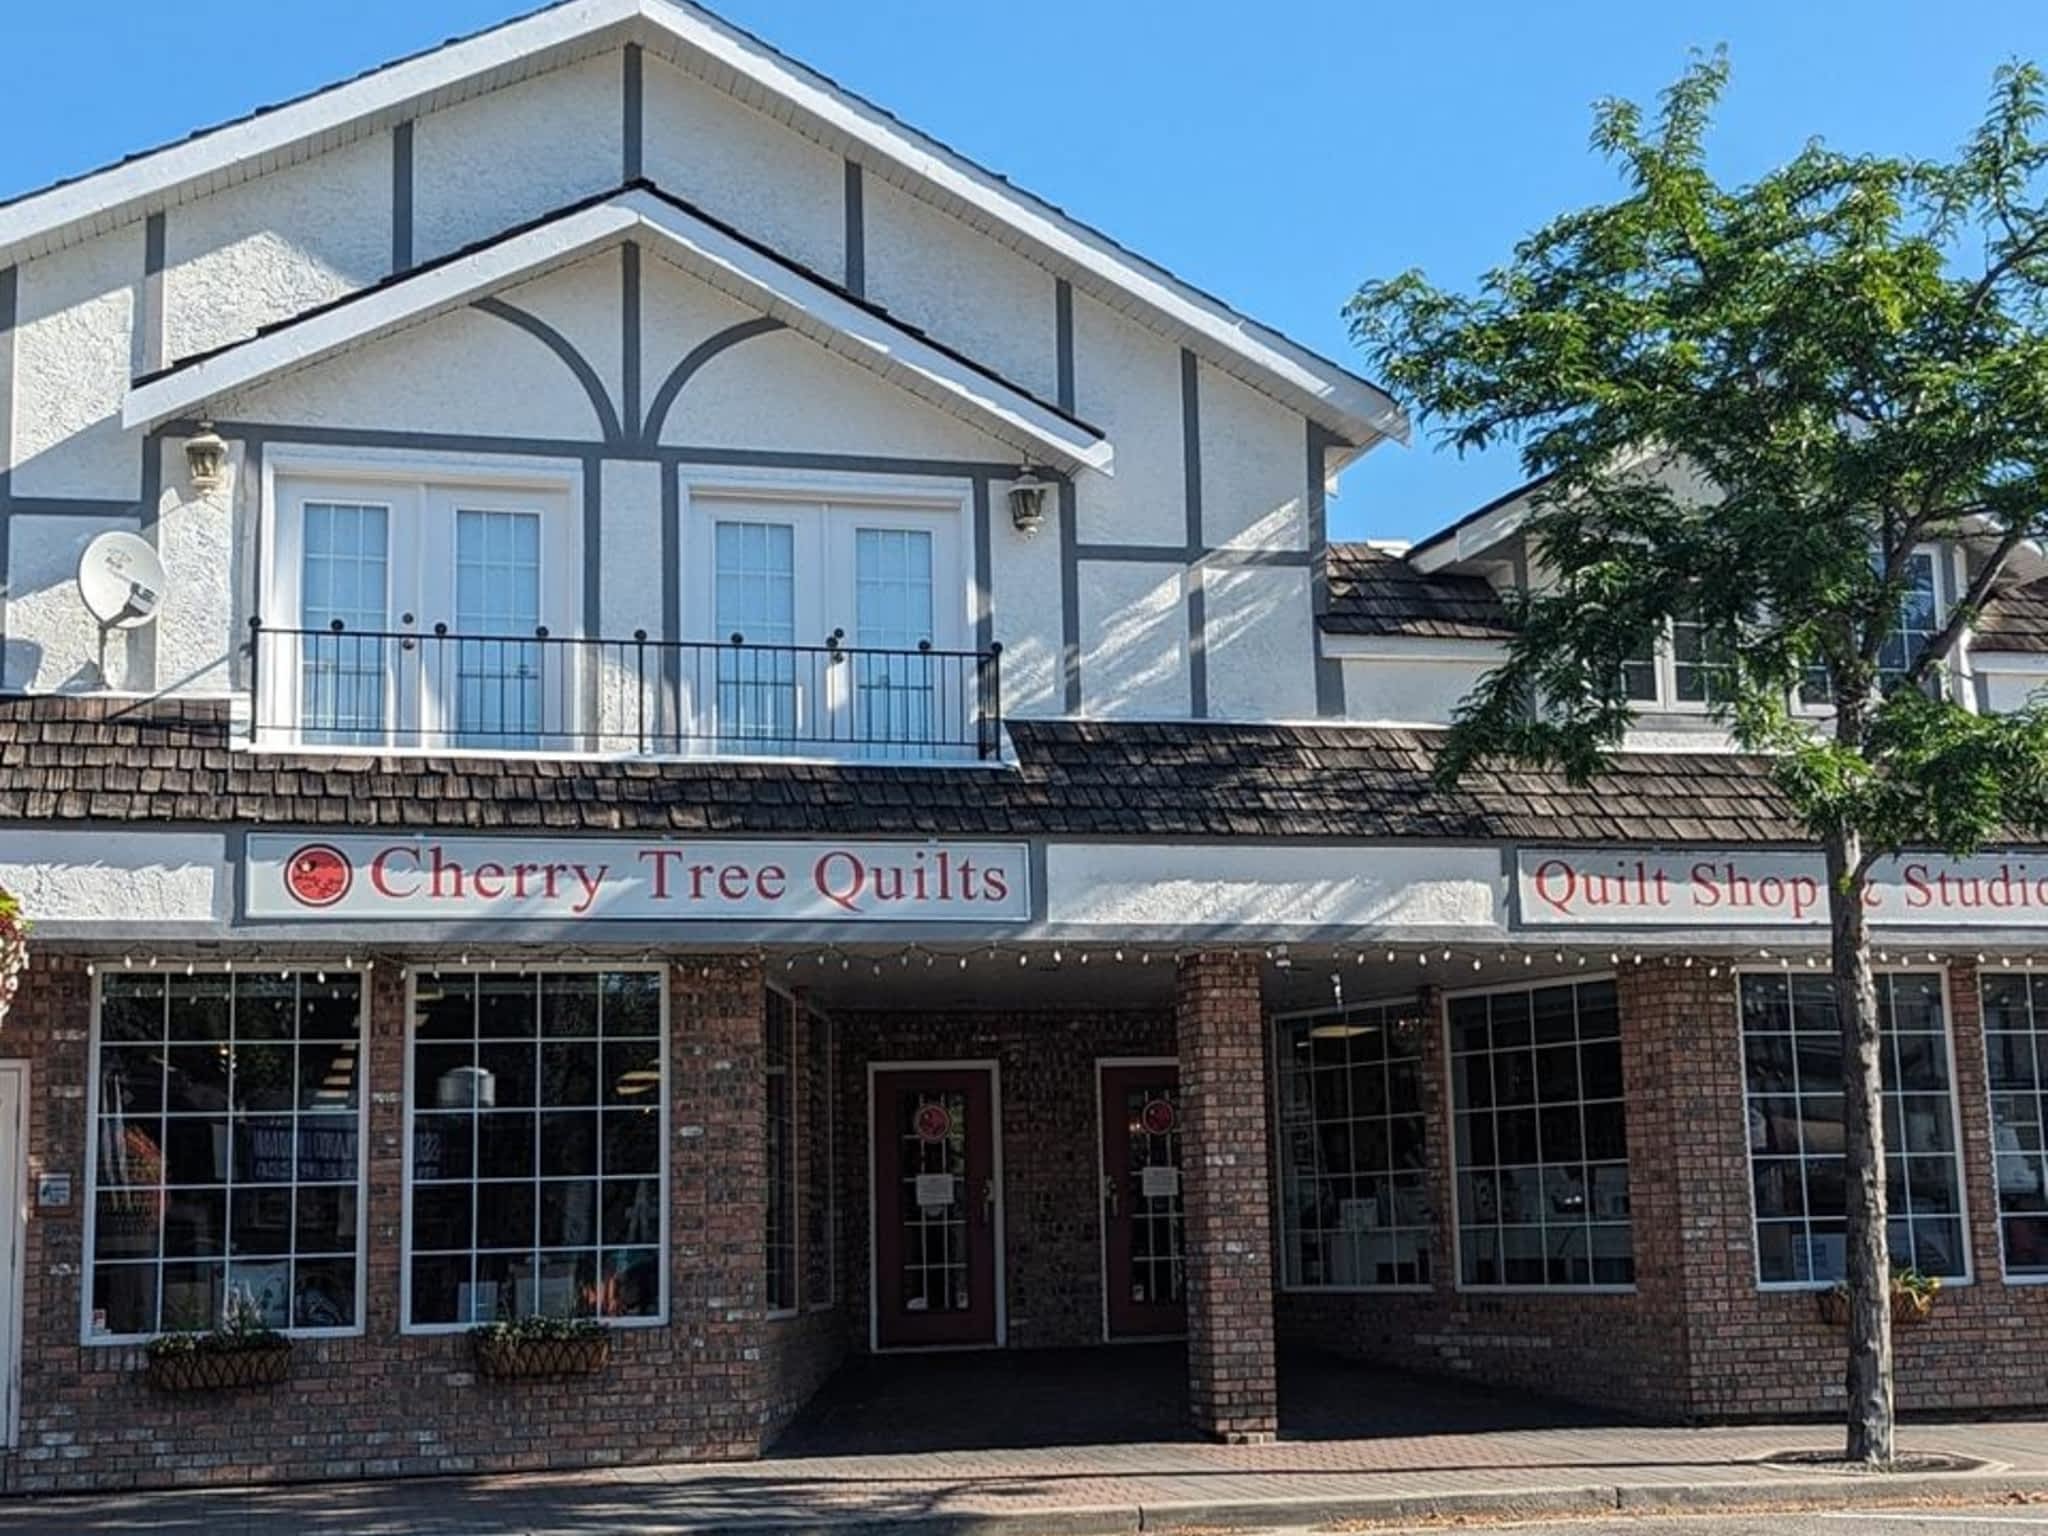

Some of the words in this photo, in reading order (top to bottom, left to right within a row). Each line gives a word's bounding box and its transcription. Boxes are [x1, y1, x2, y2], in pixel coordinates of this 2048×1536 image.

[372, 846, 609, 912] Cherry
[638, 850, 787, 900] Tree
[814, 851, 1009, 913] Quilts
[1535, 859, 1670, 916] Quilt
[1691, 863, 1819, 919] Shop
